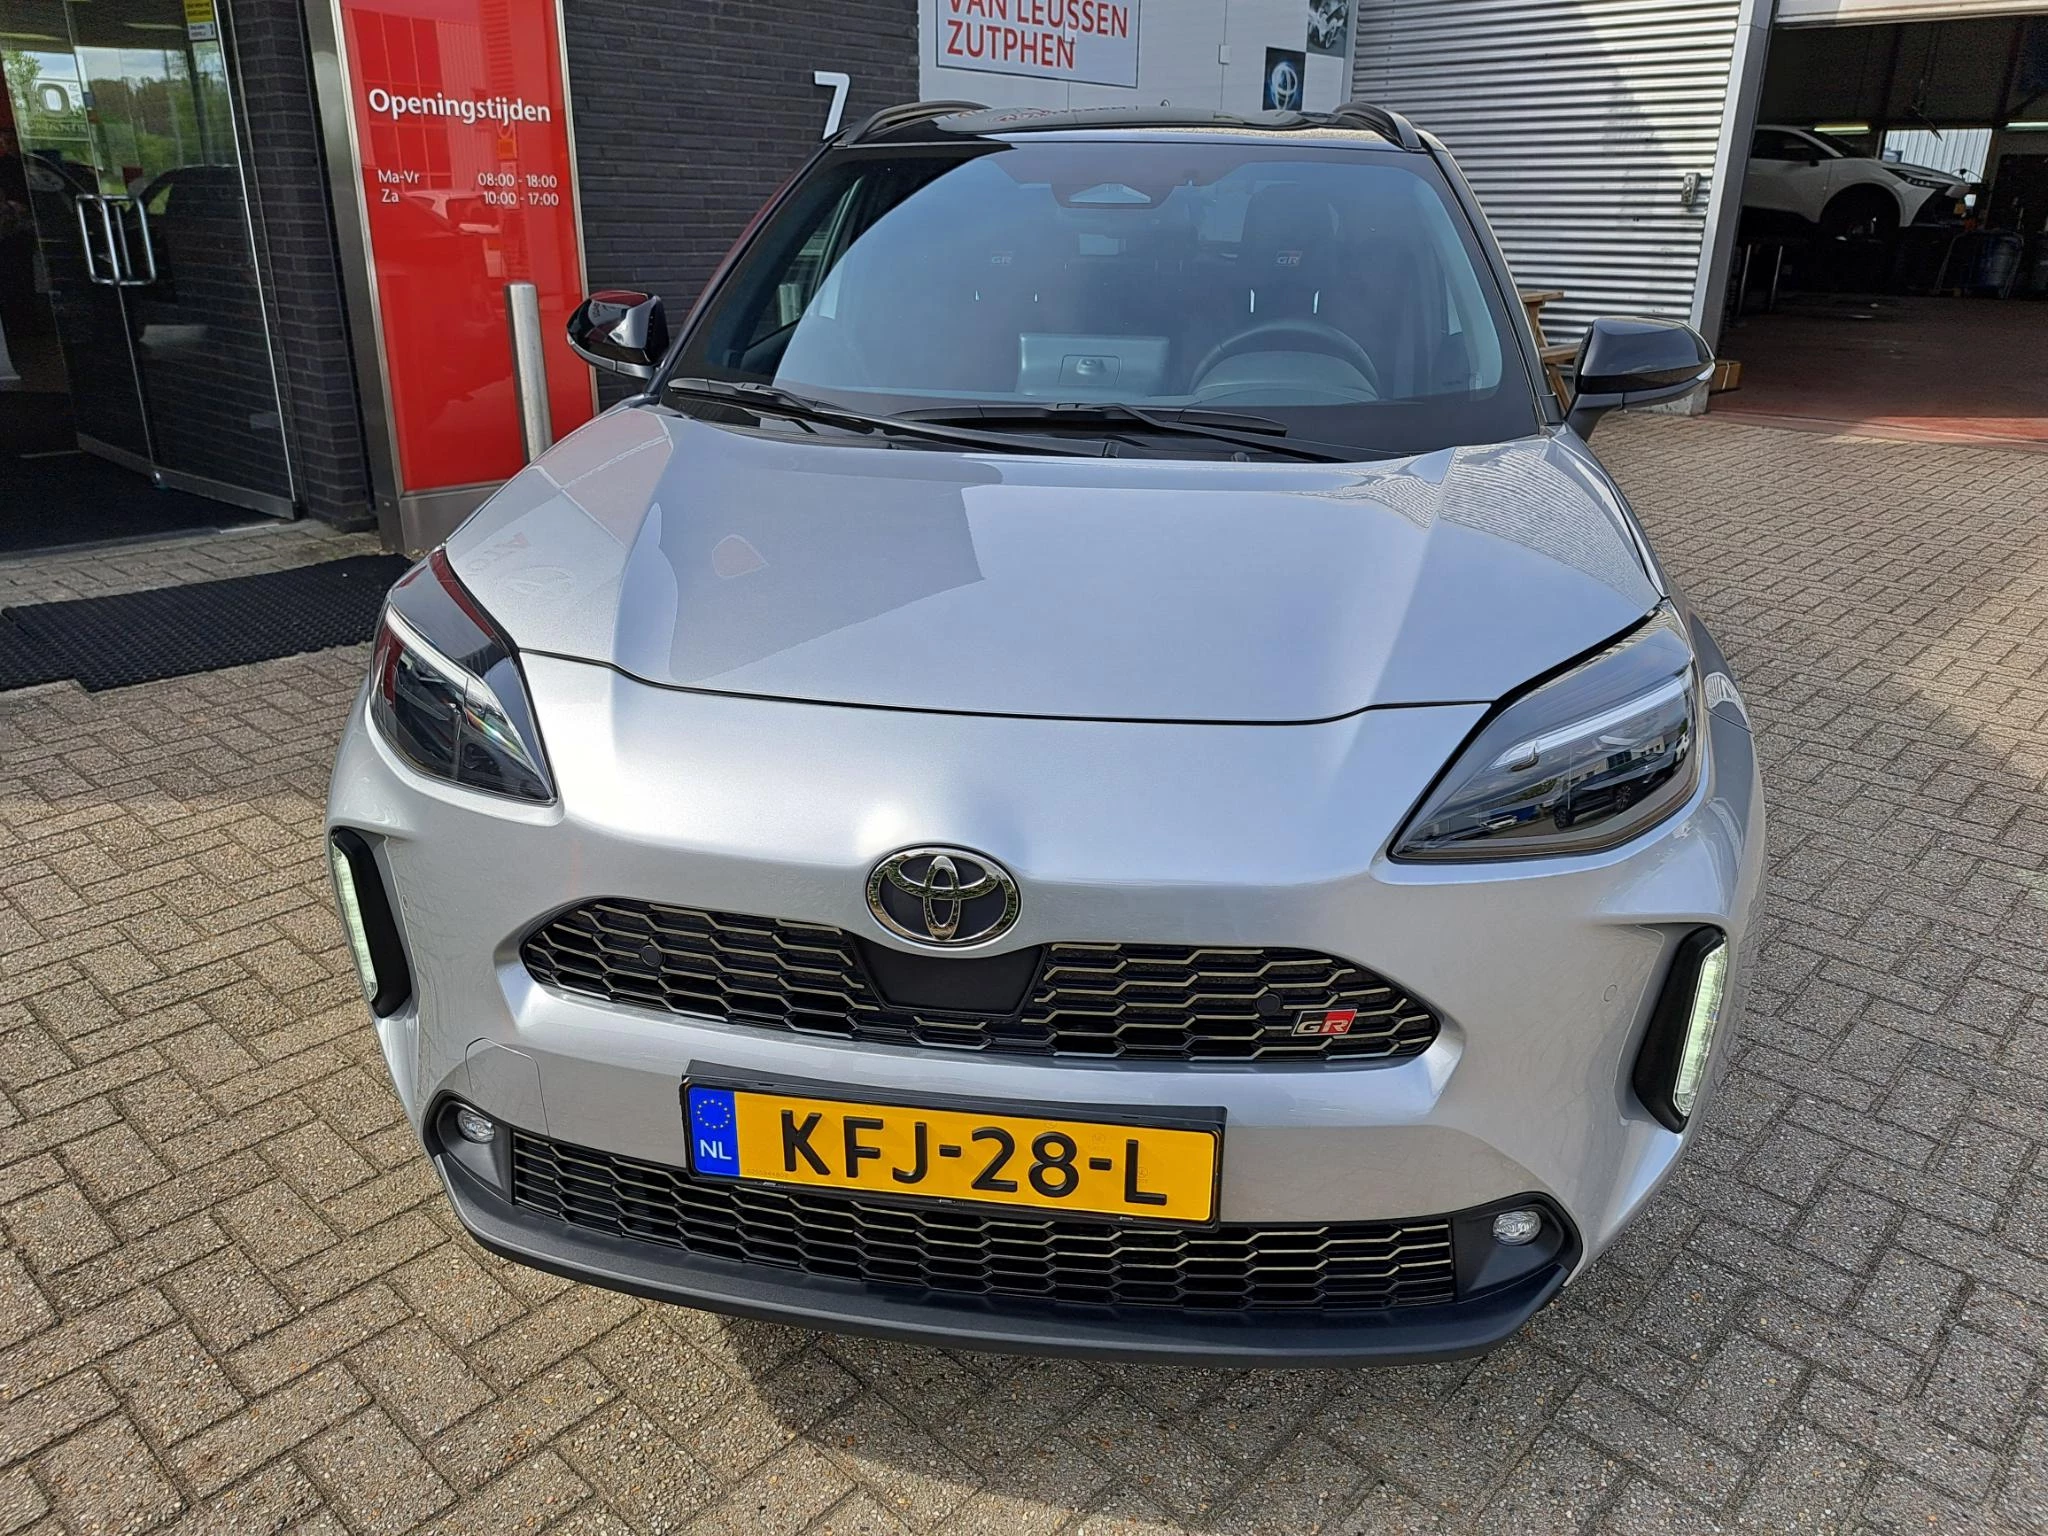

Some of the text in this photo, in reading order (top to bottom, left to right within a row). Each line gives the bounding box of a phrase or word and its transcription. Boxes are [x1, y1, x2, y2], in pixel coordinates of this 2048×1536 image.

[1017, 0, 1128, 38] LEUSSEN
[947, 19, 1075, 69] ZUTPHEN
[369, 88, 551, 126] Openingstijden
[813, 71, 850, 140] 7
[378, 169, 420, 184] Ma-Vr
[478, 172, 515, 187] 08:00
[527, 174, 558, 188] 18:00
[382, 188, 400, 203] Za
[483, 191, 517, 205] 10:00
[528, 193, 559, 206] 17:00
[1297, 1019, 1350, 1034] GR
[700, 1139, 732, 1160] NL
[780, 1109, 1168, 1206] KFJ-28-L
